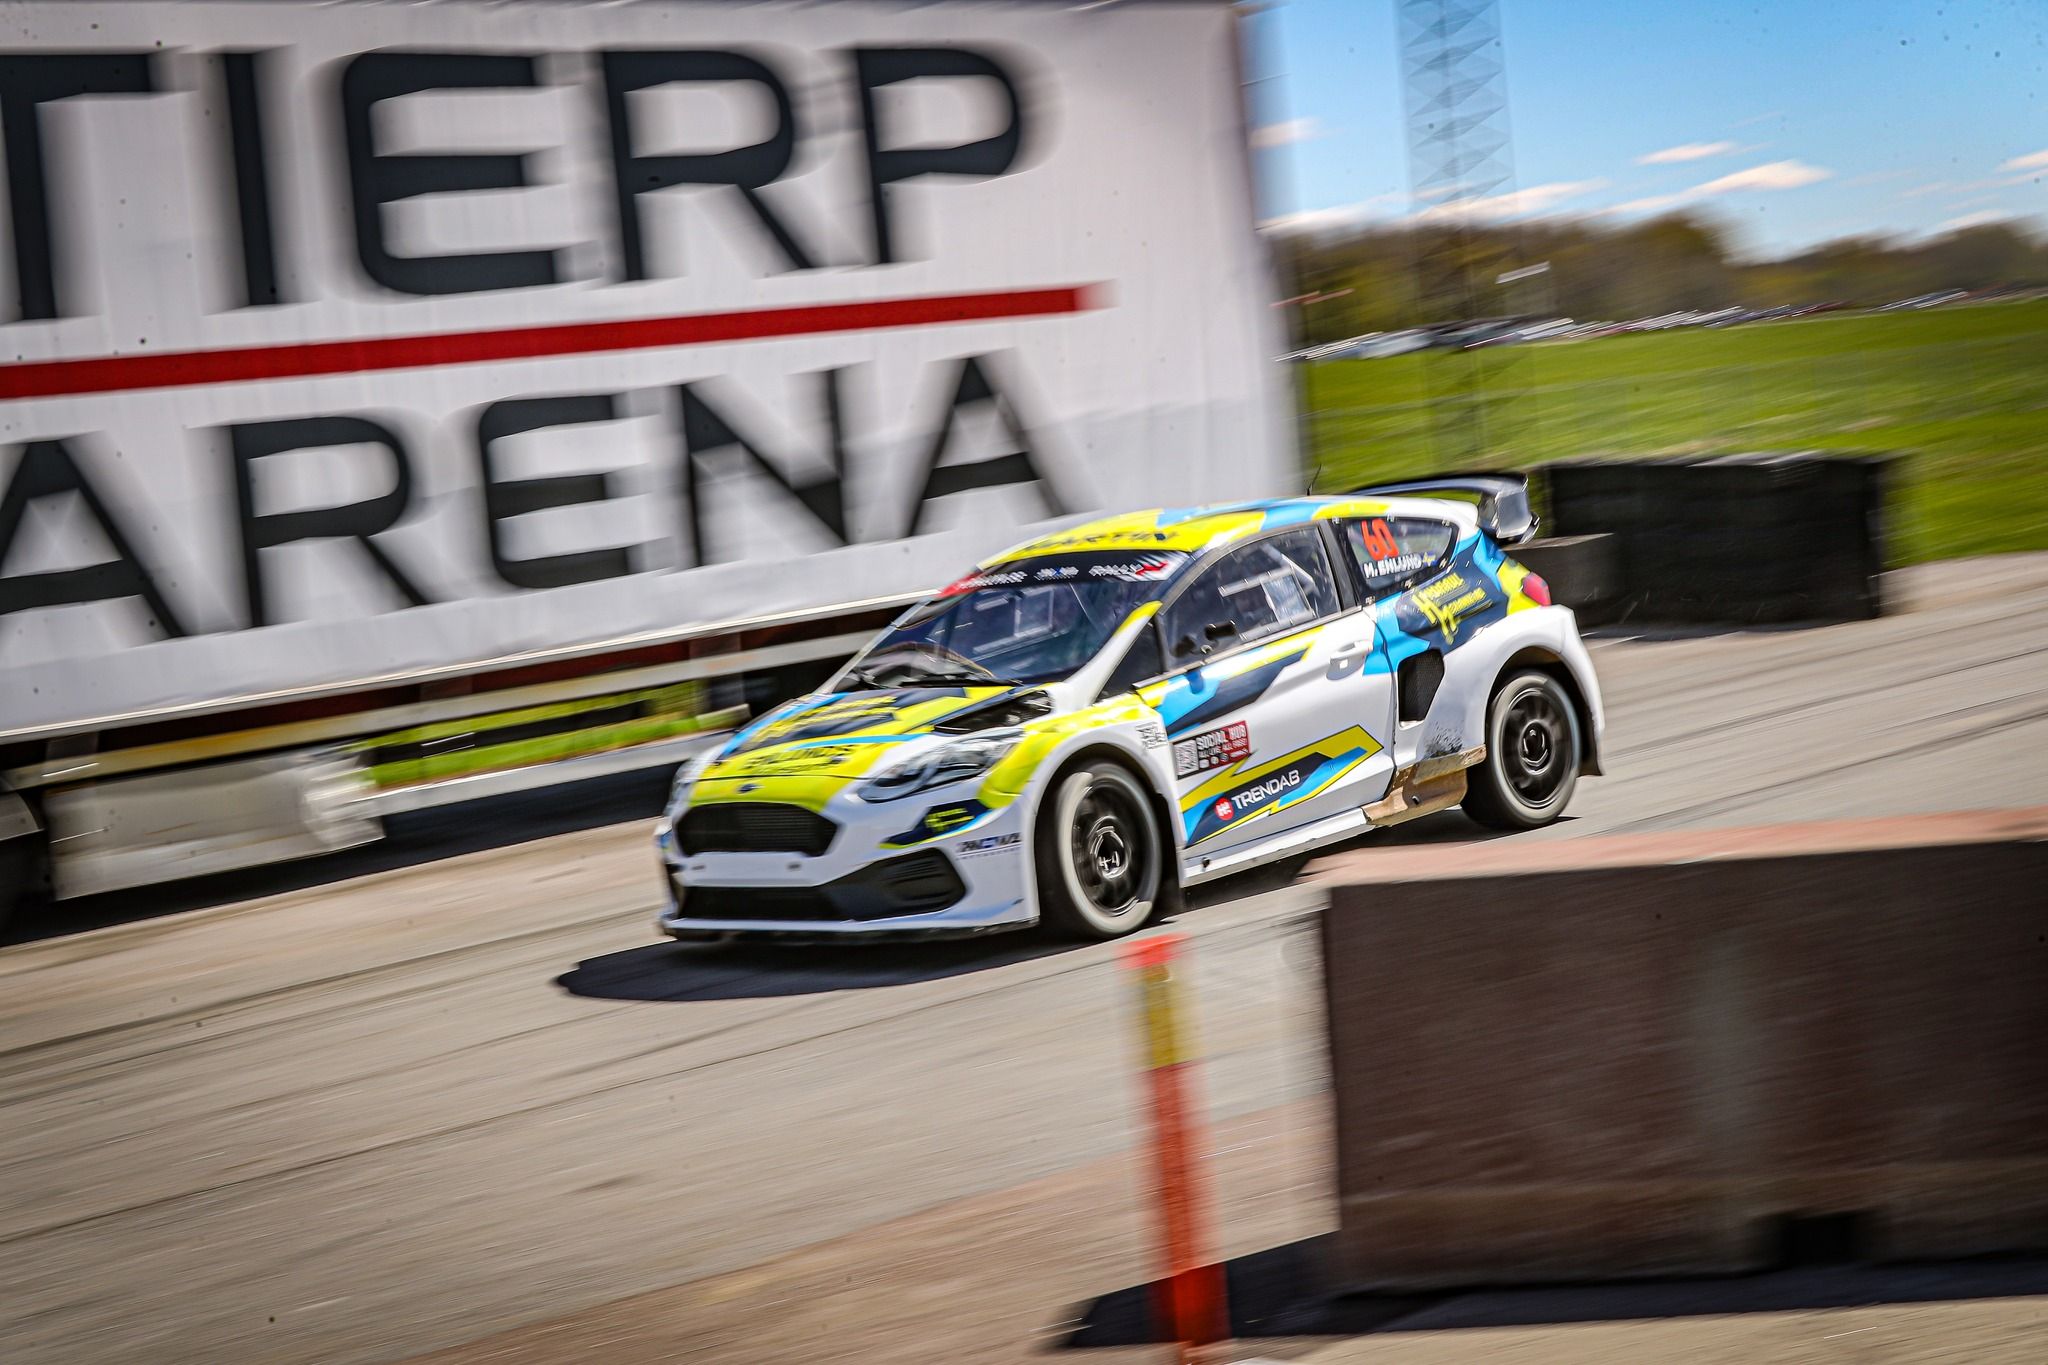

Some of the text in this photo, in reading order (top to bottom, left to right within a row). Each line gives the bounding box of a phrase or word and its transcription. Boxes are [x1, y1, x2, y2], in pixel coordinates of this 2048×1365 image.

[0, 46, 1036, 322] TIERP
[0, 352, 1075, 638] ARENA
[1361, 518, 1399, 561] 60
[1231, 769, 1300, 810] TRENDAB
